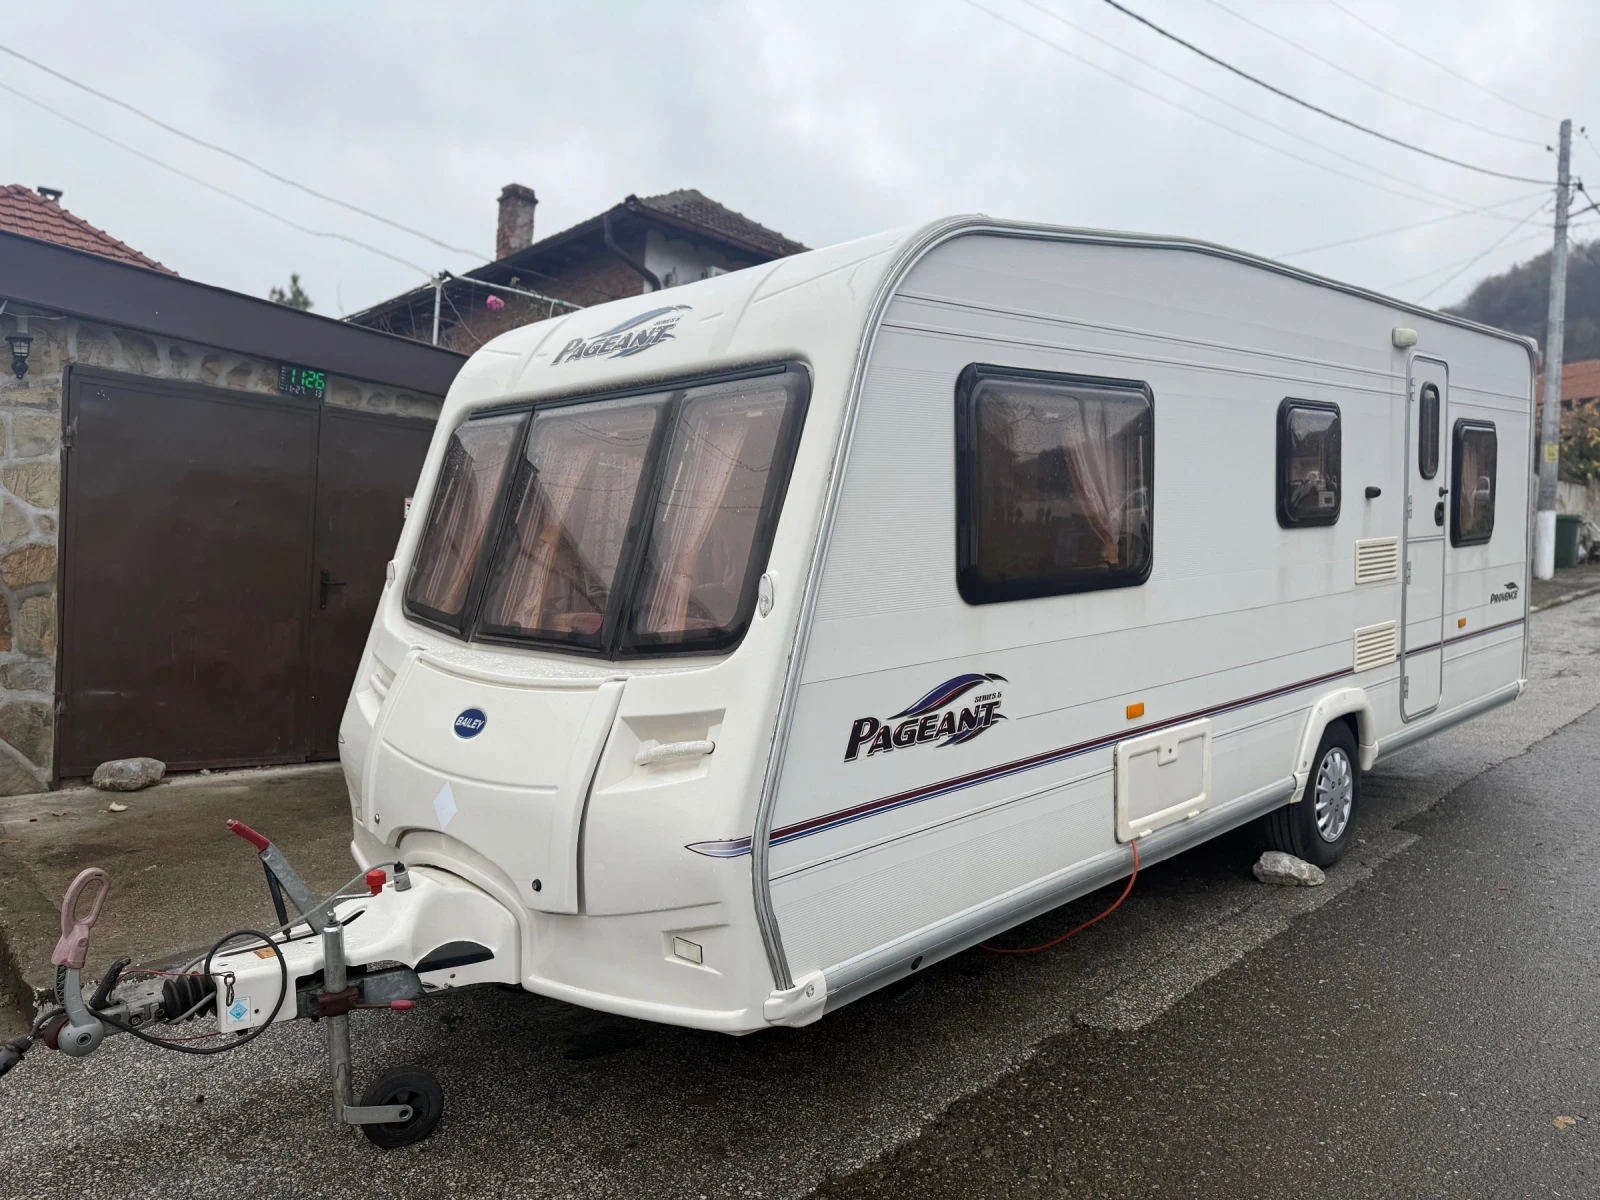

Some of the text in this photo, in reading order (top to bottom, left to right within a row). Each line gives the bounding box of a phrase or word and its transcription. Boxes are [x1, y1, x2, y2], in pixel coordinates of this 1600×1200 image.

[550, 323, 676, 366] PAGEANT
[1490, 590, 1518, 605] PROVENCE
[974, 692, 997, 703] SERIES
[455, 716, 485, 730] BAILEY
[843, 700, 1001, 763] PAGEANT
